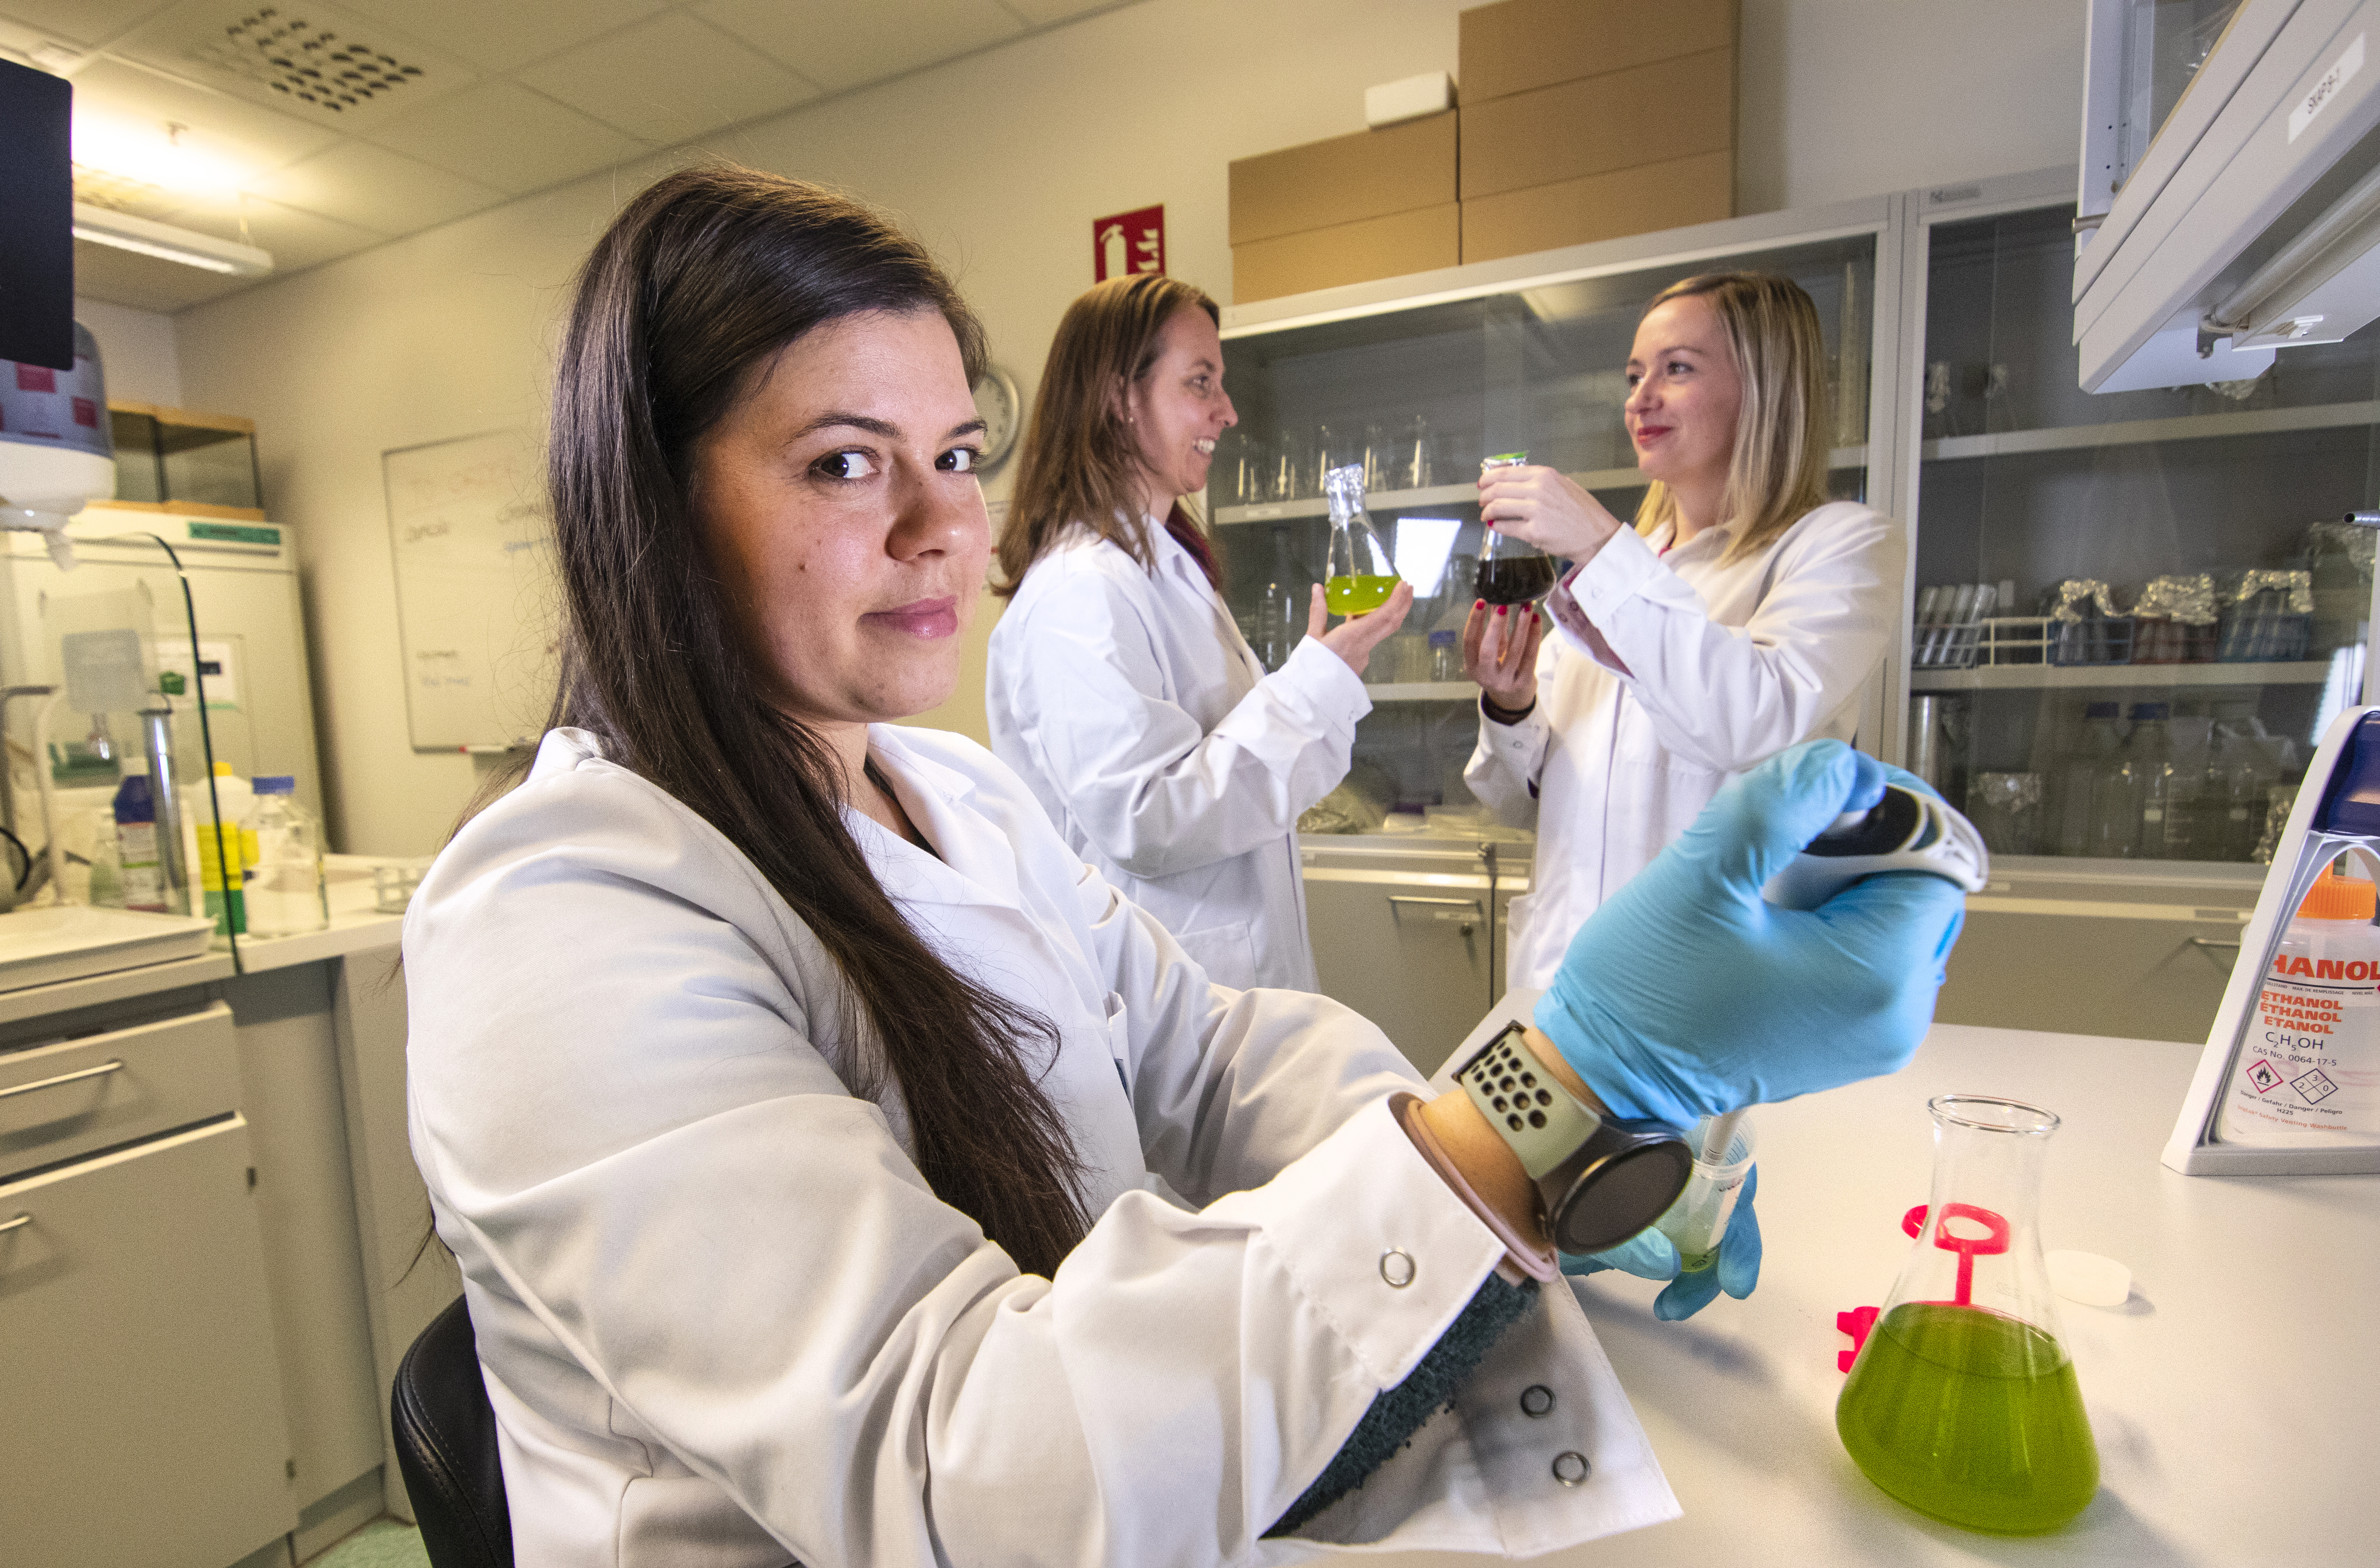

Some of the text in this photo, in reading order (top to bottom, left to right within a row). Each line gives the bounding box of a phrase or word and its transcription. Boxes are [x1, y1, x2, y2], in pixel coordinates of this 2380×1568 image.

[2261, 991, 2343, 1010] ETHANOL
[2260, 1001, 2342, 1022] ÉTHANOL
[2264, 1015, 2334, 1034] ETANOL
[2253, 1046, 2337, 1066] CAS No. 0064-17-5
[2240, 1090, 2257, 1099] Danger
[2262, 1098, 2283, 1106] Gefahr
[2289, 1104, 2313, 1112] Danger
[2259, 1112, 2278, 1122] Safety
[2281, 1118, 2307, 1128] Venting
